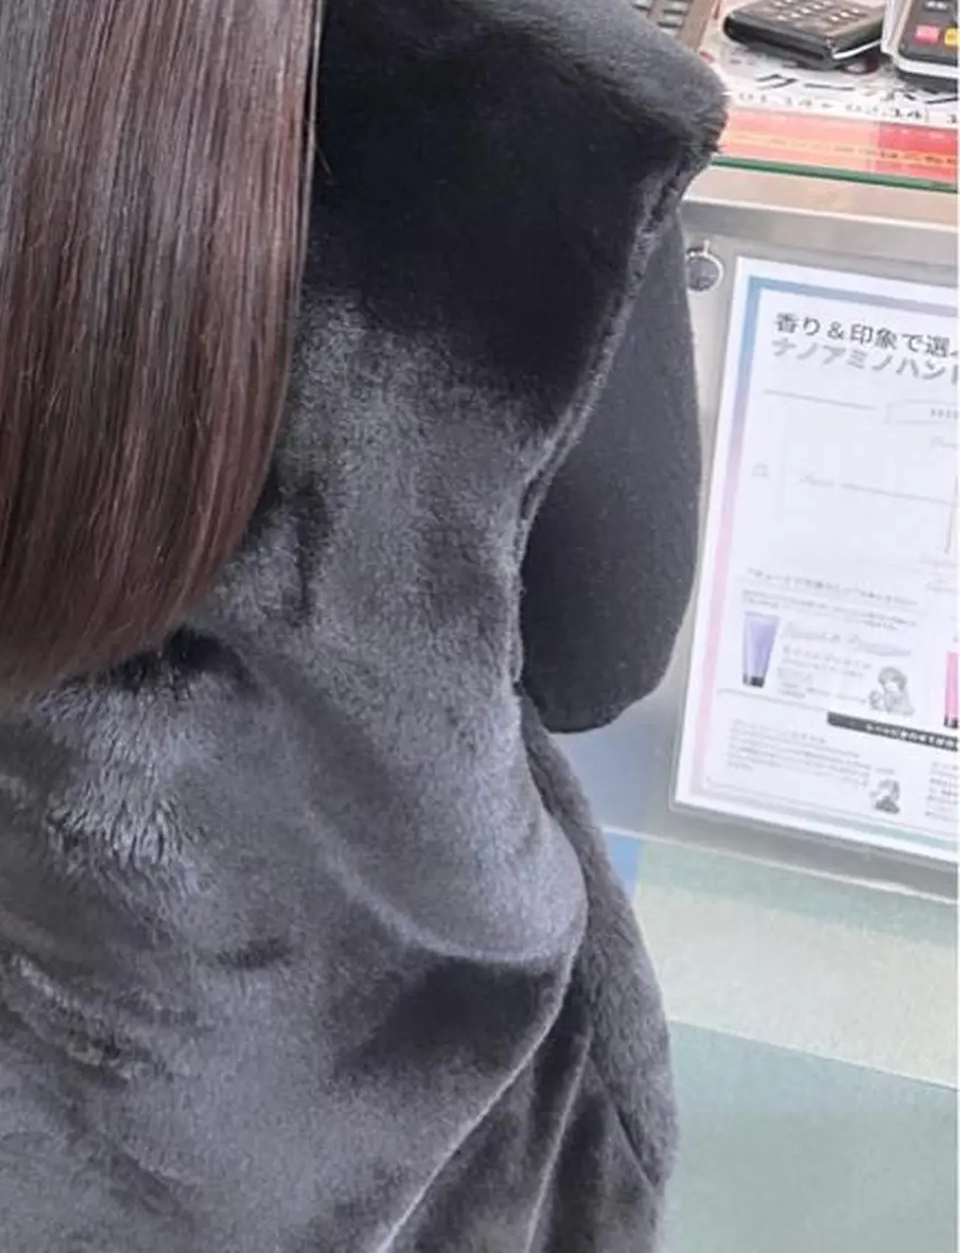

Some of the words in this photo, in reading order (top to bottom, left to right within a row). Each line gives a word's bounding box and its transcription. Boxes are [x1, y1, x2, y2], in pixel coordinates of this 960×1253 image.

[775, 312, 958, 358] 香り＆印象で選
